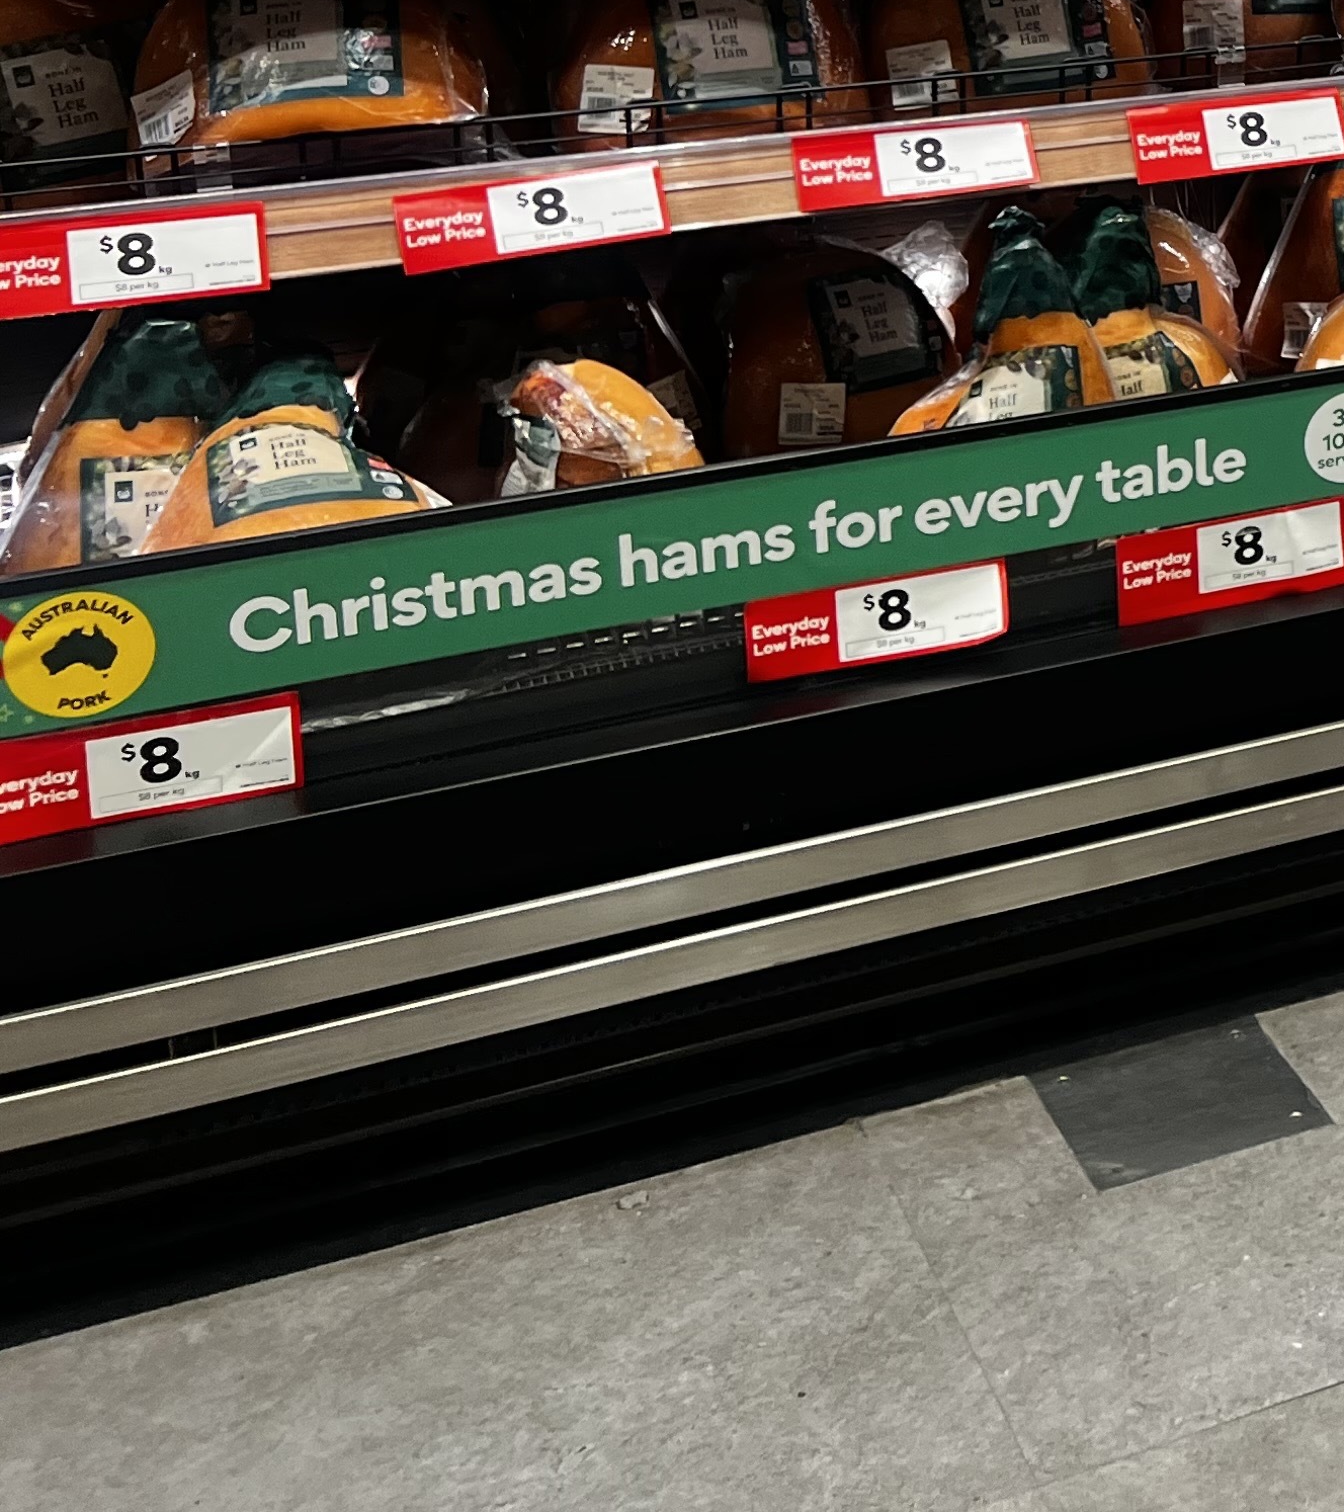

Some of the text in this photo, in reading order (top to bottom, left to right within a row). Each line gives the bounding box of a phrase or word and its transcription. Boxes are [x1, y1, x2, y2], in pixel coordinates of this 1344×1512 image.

[266, 10, 300, 26] Half
[1014, 5, 1041, 19] Half
[708, 17, 738, 32] Half
[1017, 20, 1041, 34] Leg
[267, 39, 306, 53] Ham
[711, 33, 738, 46] Leg
[1020, 33, 1050, 46] Ham
[714, 46, 748, 59] Ham
[50, 76, 85, 99] Half
[54, 96, 87, 113] Leg
[58, 110, 99, 128] Ham
[1226, 111, 1268, 147] $8
[1136, 131, 1200, 148] Everyday
[900, 137, 960, 173] $8 kg
[1140, 144, 1203, 161] Low Price
[799, 155, 870, 173] Everyday
[803, 169, 873, 186] Low Price
[517, 187, 568, 225] $8
[403, 211, 483, 233] Everyday
[407, 226, 486, 249] Low Price
[100, 233, 156, 275] $8
[15, 273, 61, 288] Price
[989, 393, 1017, 409] Half
[271, 439, 306, 451] Half
[274, 457, 317, 470] Ham
[229, 437, 1247, 653] Christmas hams for every table
[1221, 526, 1277, 565] $8 kg
[1122, 552, 1192, 574] Everyday
[1123, 567, 1192, 590] Low Price
[863, 589, 912, 631] $8
[21, 599, 135, 642] AUSTRALIAN
[751, 615, 829, 641] Everyday
[754, 633, 830, 657] Low Price
[57, 690, 112, 710] PORK
[121, 737, 200, 783] $8 kg
[29, 787, 80, 807] Price
